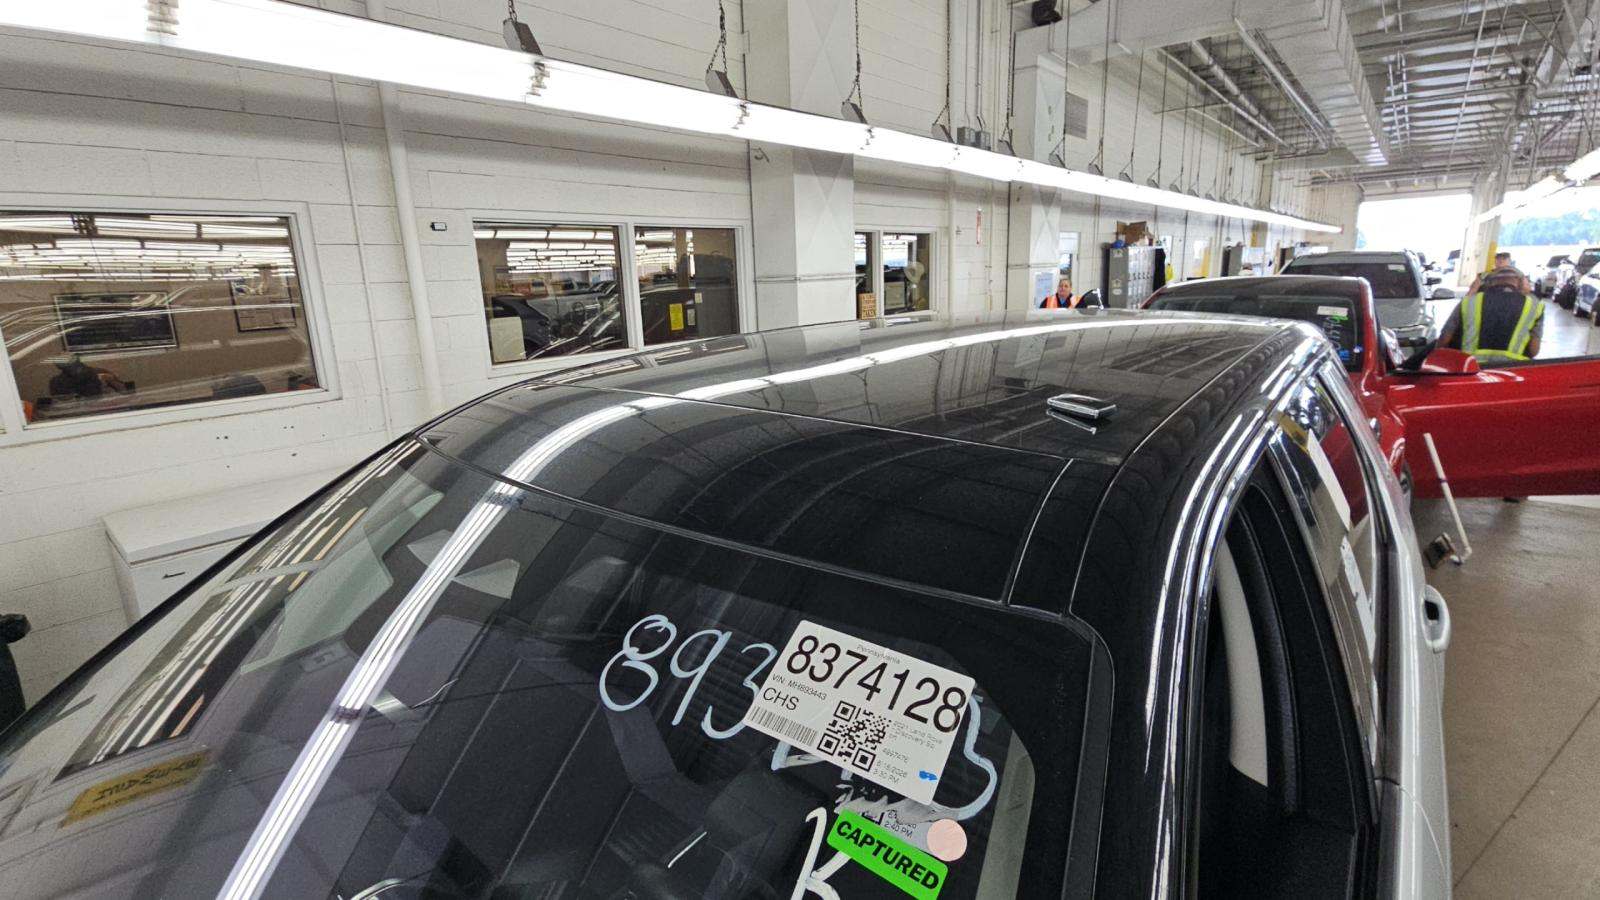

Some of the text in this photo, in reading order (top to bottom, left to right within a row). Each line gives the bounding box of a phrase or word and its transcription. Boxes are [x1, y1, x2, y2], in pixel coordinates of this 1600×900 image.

[763, 687, 799, 711] CHS
[787, 635, 966, 733] 8374128
[884, 821, 914, 839] 2:40 PM
[837, 820, 940, 890] CAPTURED
